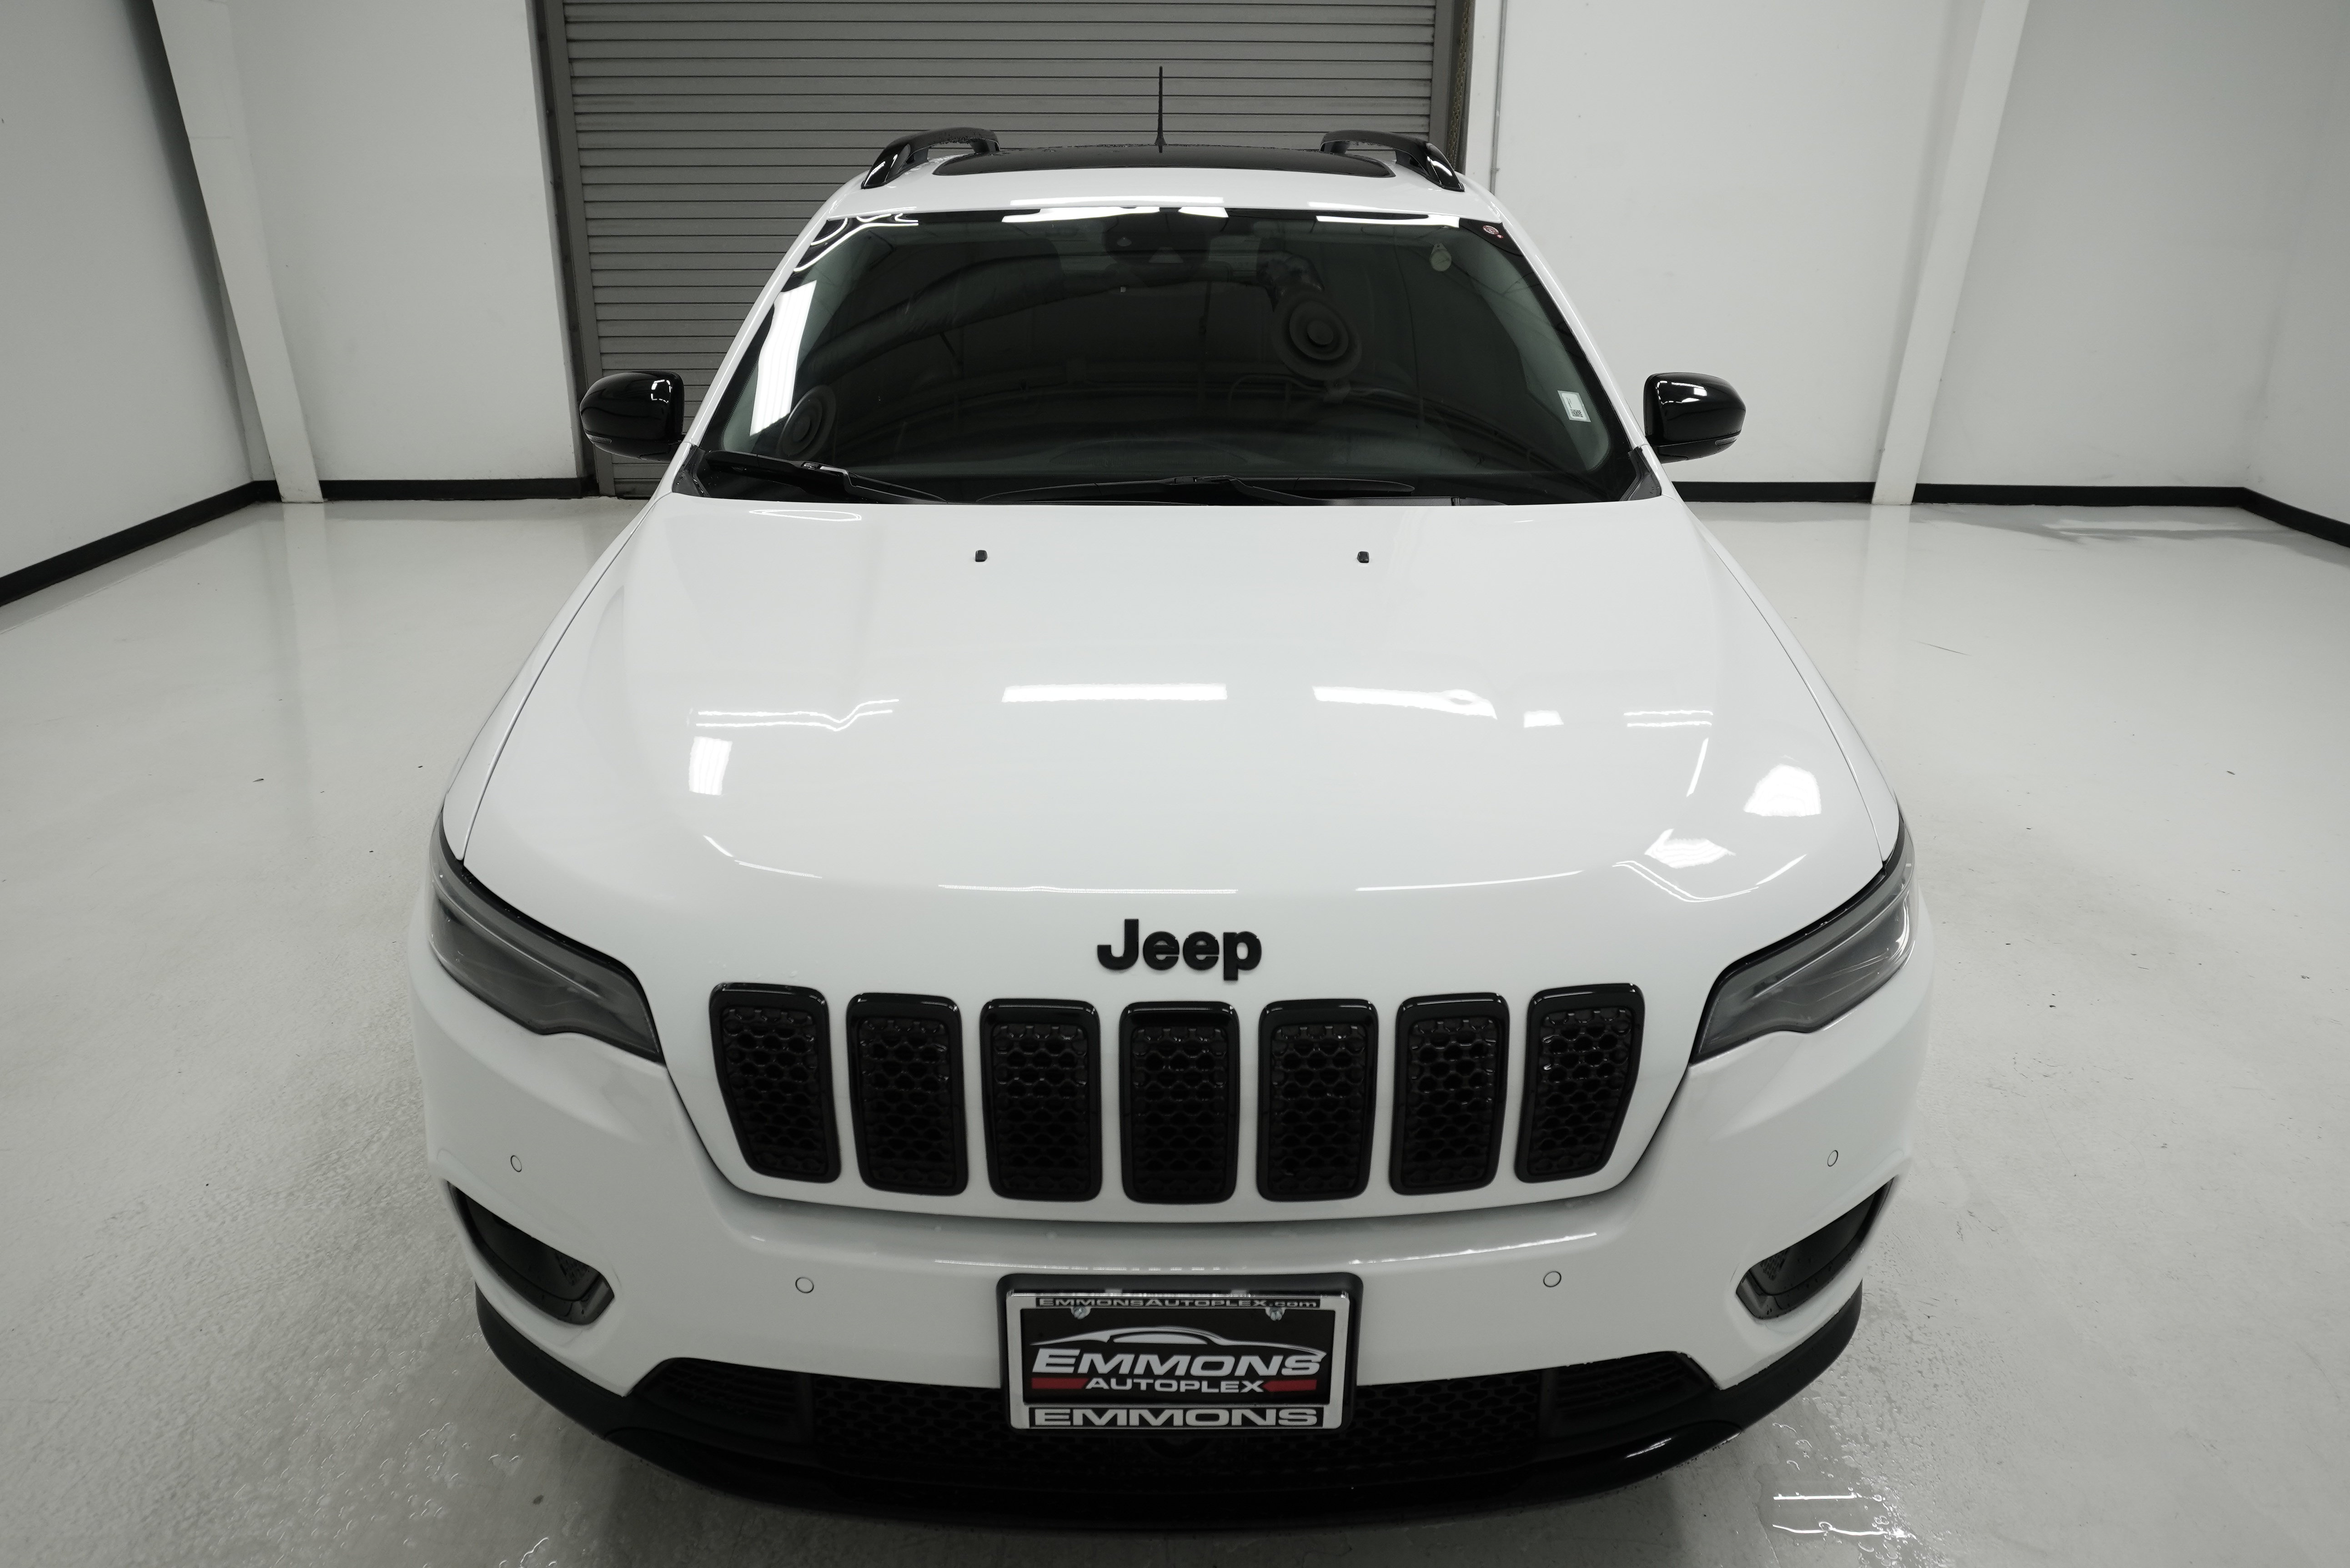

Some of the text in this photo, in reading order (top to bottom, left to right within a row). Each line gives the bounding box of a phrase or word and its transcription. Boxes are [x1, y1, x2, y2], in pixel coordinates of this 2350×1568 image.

[1097, 919, 1262, 981] Jeep
[1032, 1347, 1321, 1377] EMMONS
[1085, 1378, 1264, 1393] AUTOPLEX
[1034, 1408, 1318, 1427] EMMONS
